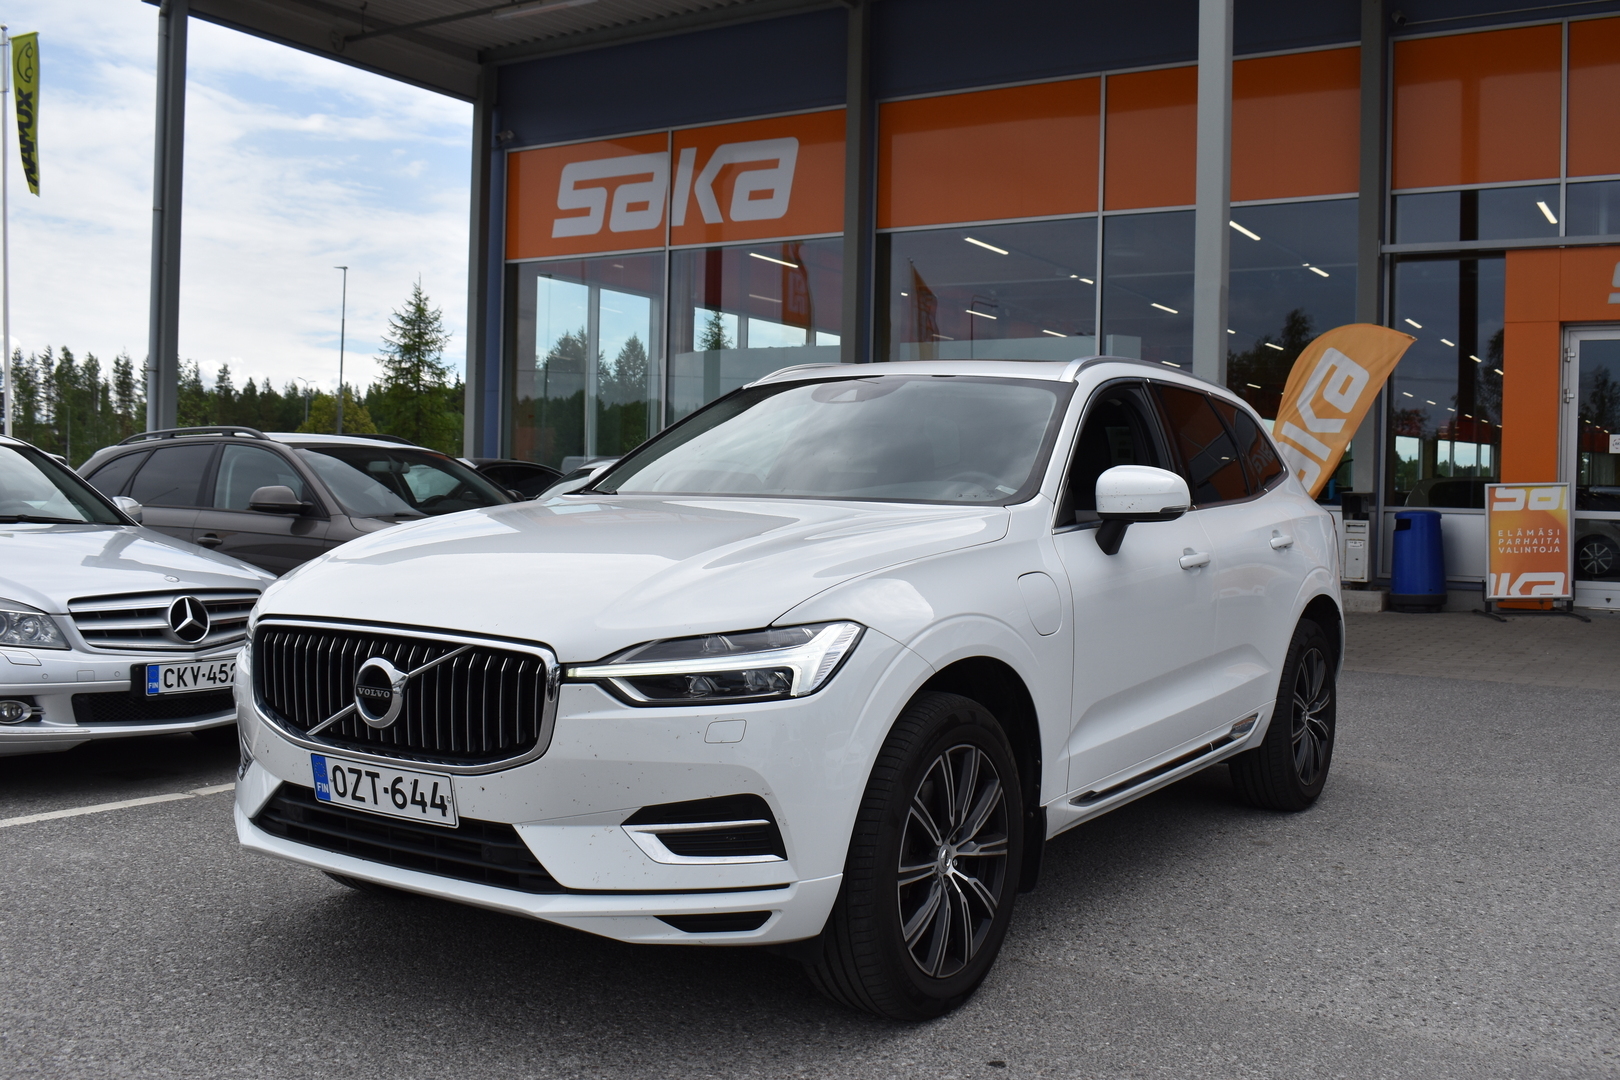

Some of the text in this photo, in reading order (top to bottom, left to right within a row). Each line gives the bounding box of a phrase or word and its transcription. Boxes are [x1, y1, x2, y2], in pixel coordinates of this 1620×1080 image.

[551, 136, 799, 238] saka
[1498, 528, 1560, 537] ELÄMÄSI
[1498, 537, 1560, 545] PARHAITA
[148, 682, 159, 690] FIN
[357, 687, 390, 699] VOLVO
[317, 765, 448, 817] FIN OZT-644
